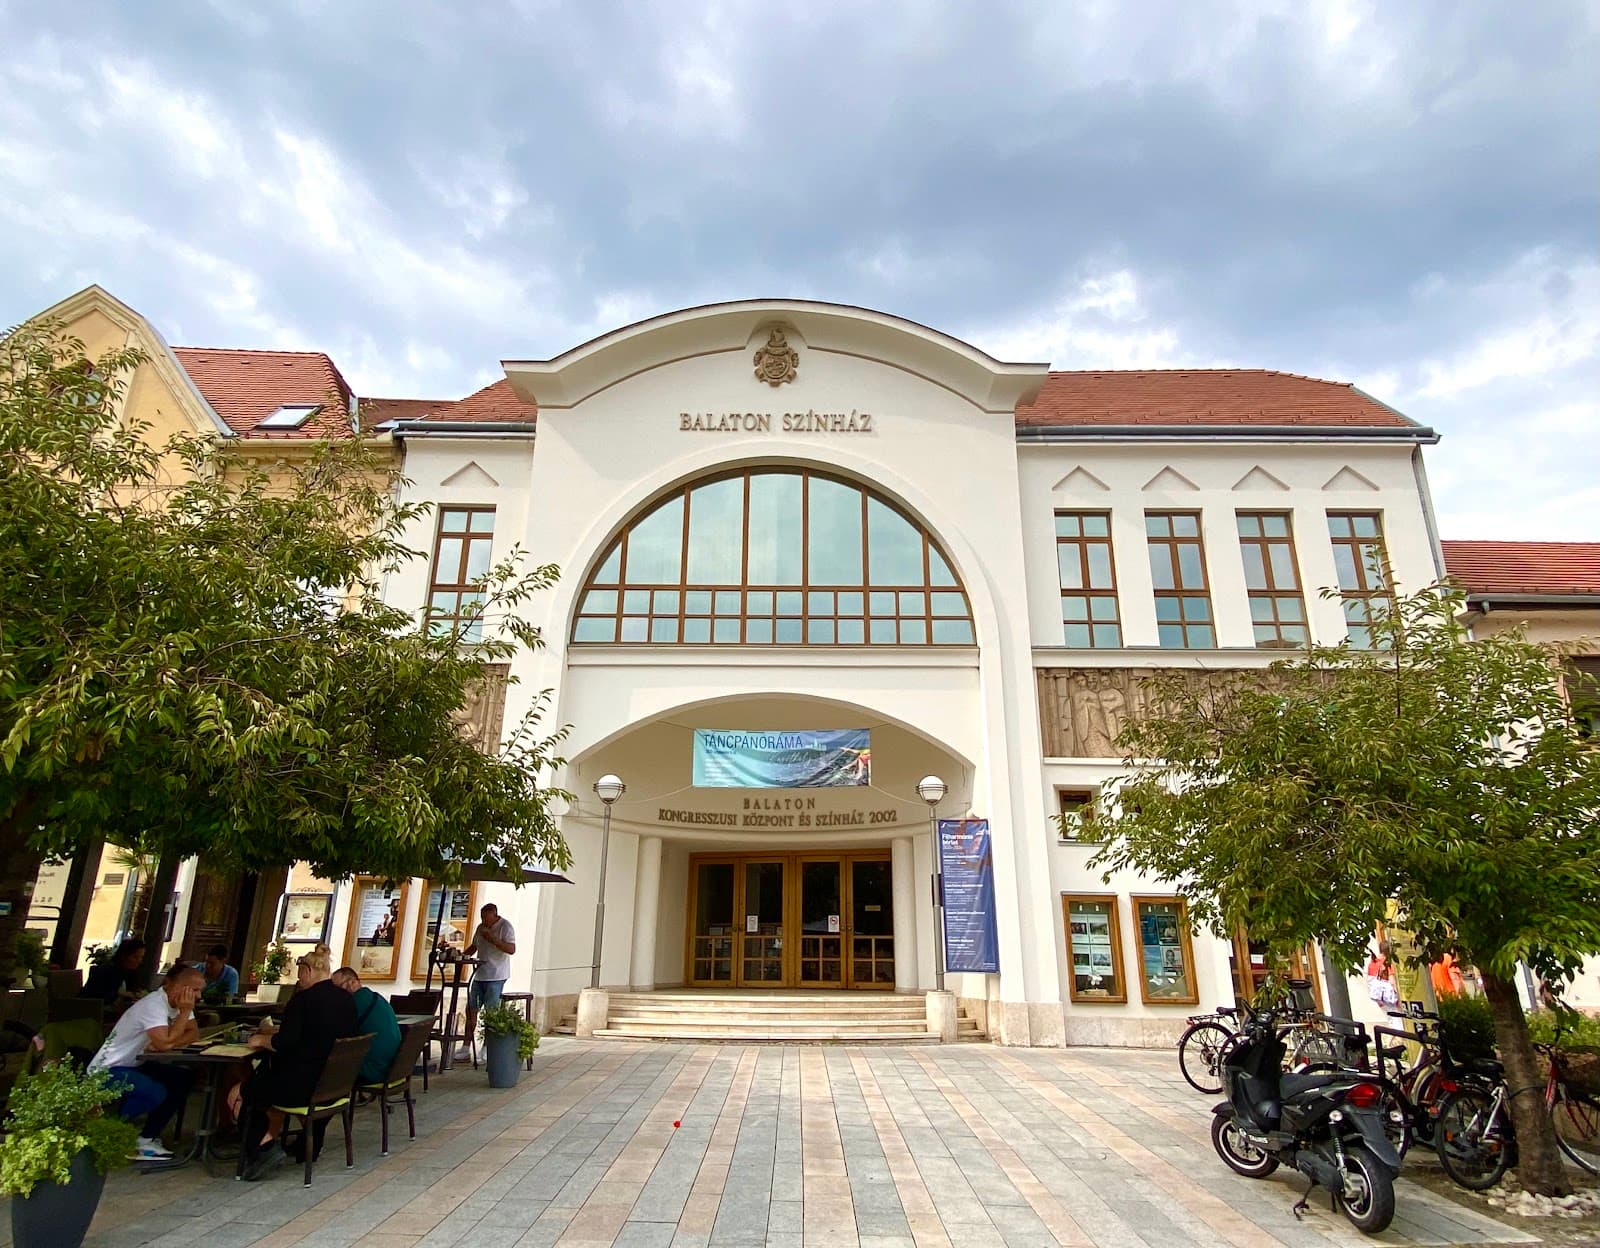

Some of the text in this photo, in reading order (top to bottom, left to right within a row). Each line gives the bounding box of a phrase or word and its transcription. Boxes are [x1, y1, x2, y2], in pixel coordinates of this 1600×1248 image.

[679, 409, 872, 432] BALATON SZÍNHÁZ
[703, 732, 803, 750] TÁNCPANORÁMA
[743, 798, 815, 810] BALATON
[658, 807, 897, 827] KONGRESSZUSI KÖZPONT ÉS SZÍNHÁZ 2002
